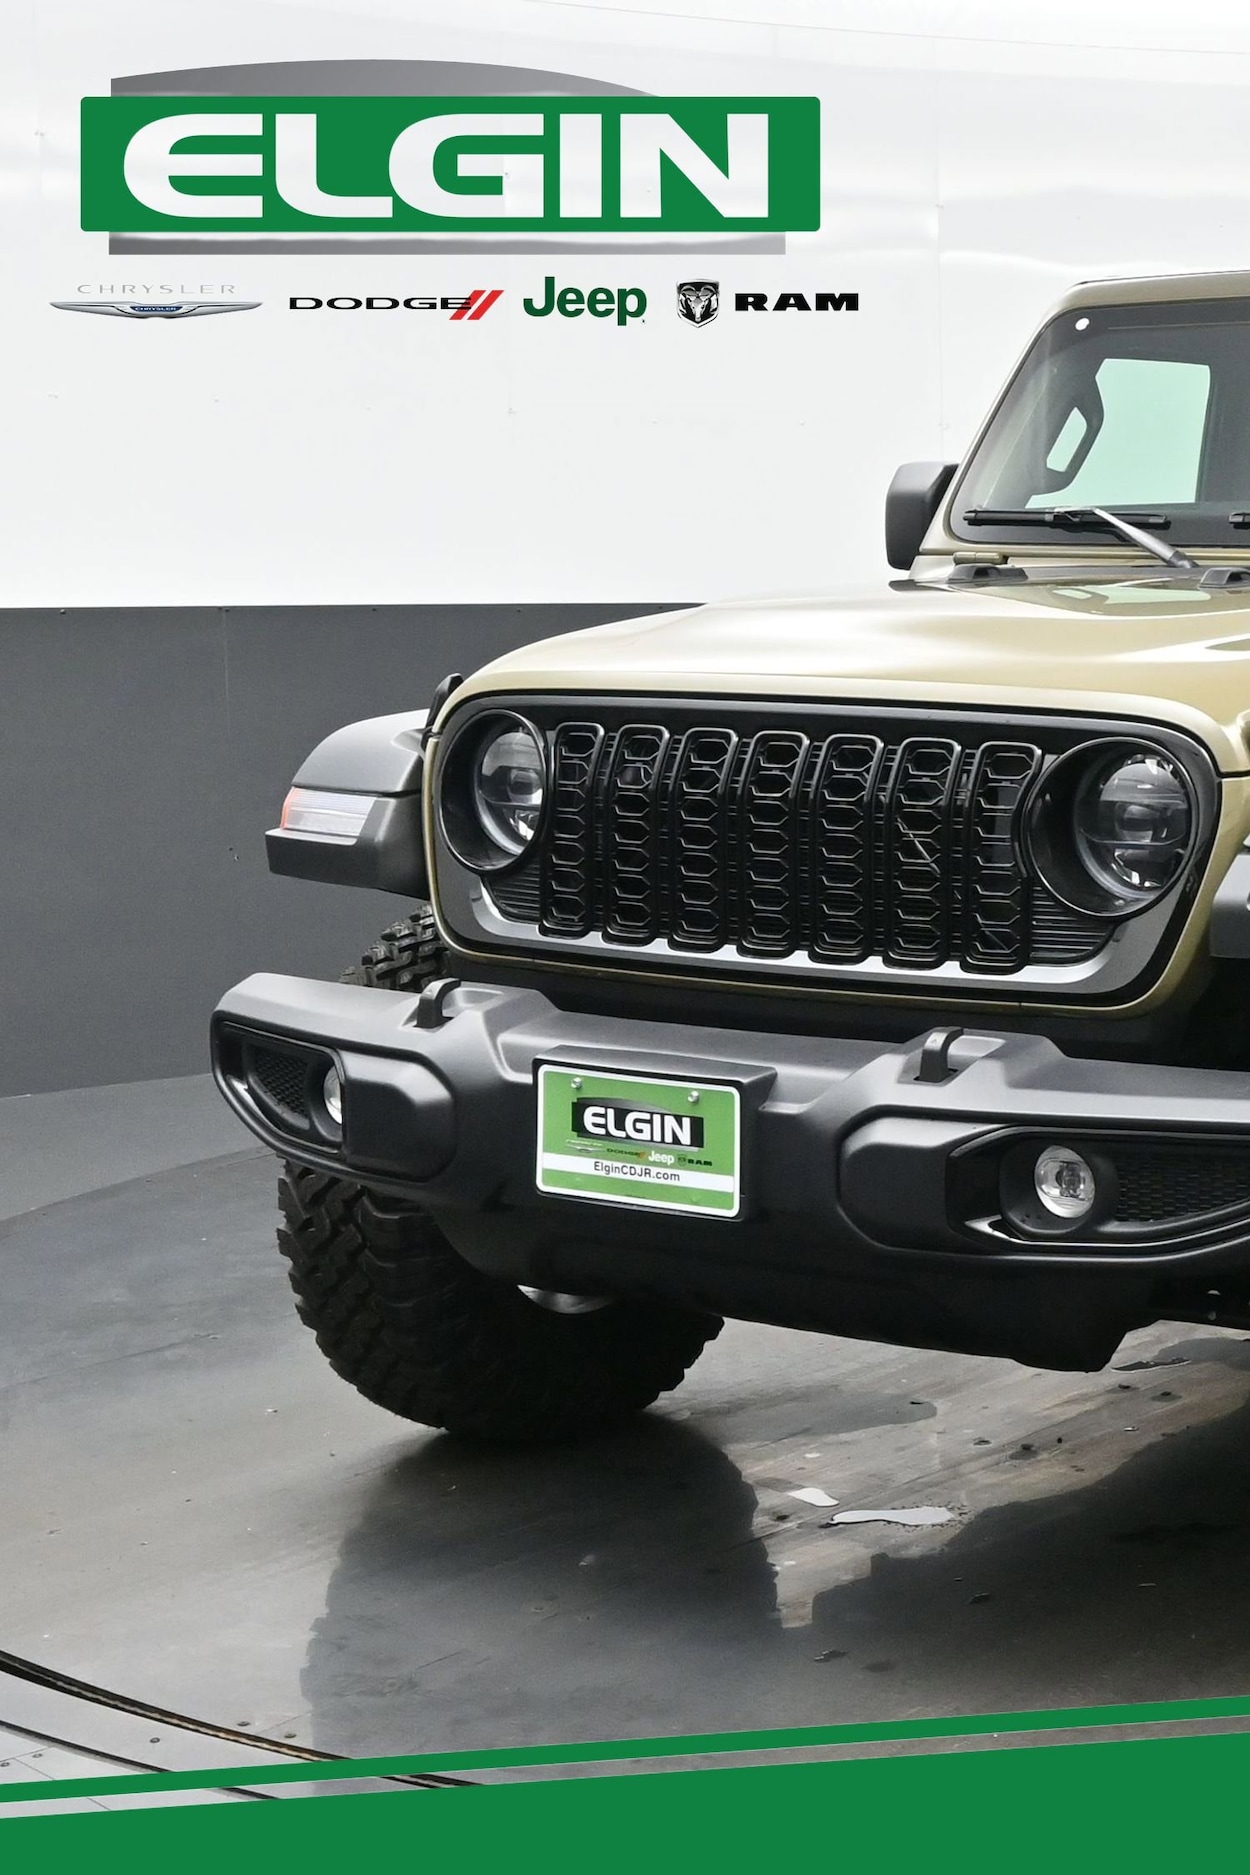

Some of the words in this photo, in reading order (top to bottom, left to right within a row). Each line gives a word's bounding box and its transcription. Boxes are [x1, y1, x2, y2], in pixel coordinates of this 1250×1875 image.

[584, 1106, 691, 1145] ELGIN
[647, 1150, 675, 1166] Jeep
[687, 1158, 713, 1167] RAM
[594, 1161, 680, 1181] ElginCDJR.com
